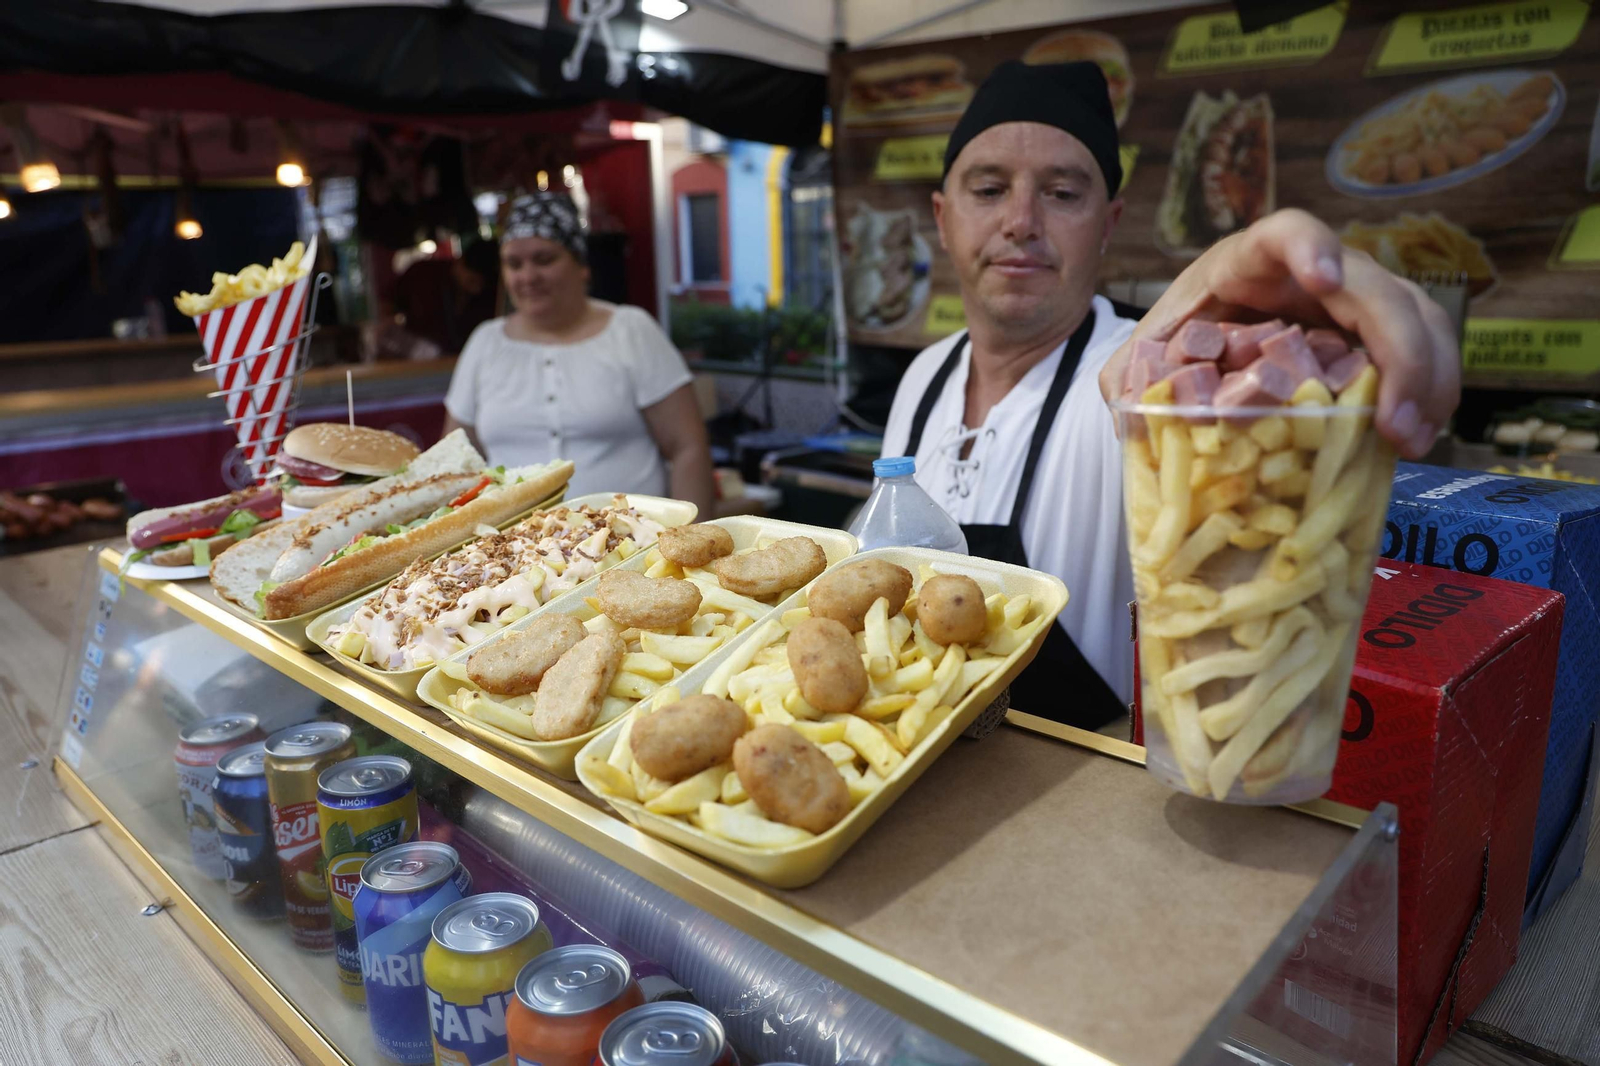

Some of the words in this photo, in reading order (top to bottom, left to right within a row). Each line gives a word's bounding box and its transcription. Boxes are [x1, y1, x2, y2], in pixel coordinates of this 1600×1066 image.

[1363, 583, 1486, 648] DIDILO
[340, 797, 367, 807] LIMÓN
[335, 877, 360, 897] Lip
[358, 941, 425, 987] UARI
[427, 987, 513, 1044] FAN
